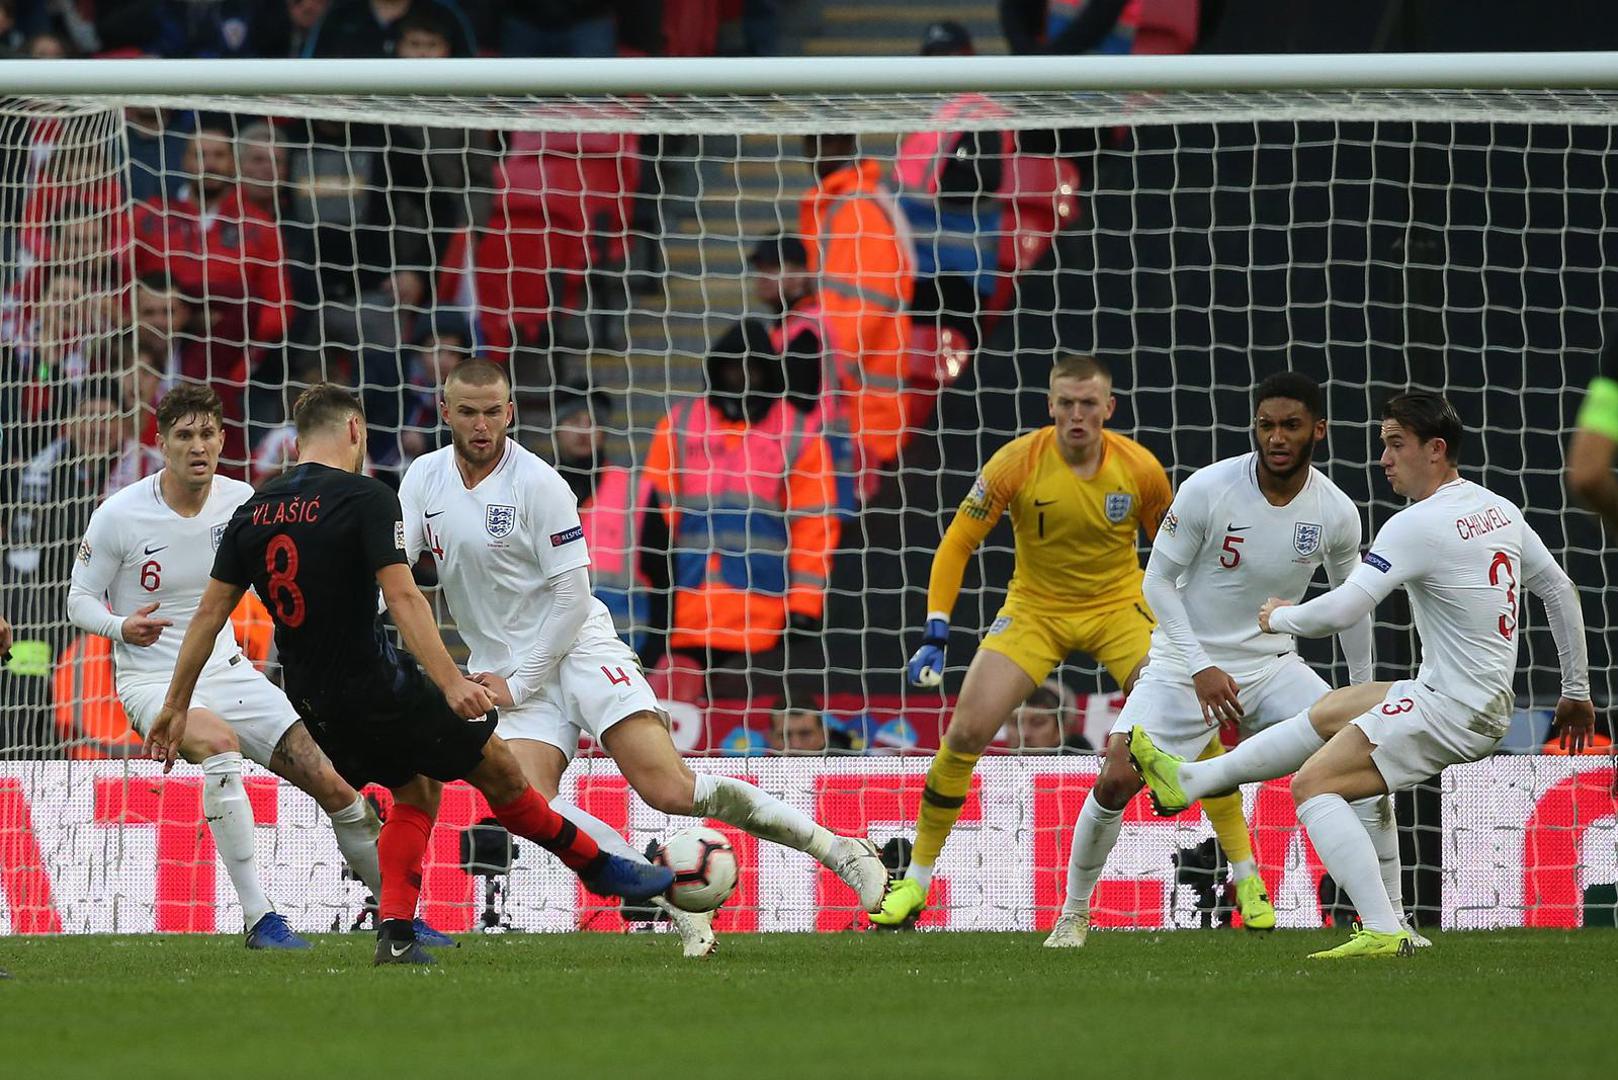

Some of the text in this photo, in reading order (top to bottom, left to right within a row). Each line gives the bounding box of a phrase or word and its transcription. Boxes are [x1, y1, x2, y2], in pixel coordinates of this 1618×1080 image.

[252, 495, 320, 526] VLAŠIĆ
[1038, 511, 1044, 538] 1
[1456, 506, 1511, 540] CHILWELL
[426, 523, 444, 560] 4
[561, 528, 583, 541] RESPEC
[1219, 535, 1244, 568] 5
[140, 560, 162, 592] 6
[265, 533, 306, 628] 8
[1488, 551, 1516, 641] 3
[600, 665, 631, 686] 4
[1381, 698, 1414, 715] 3
